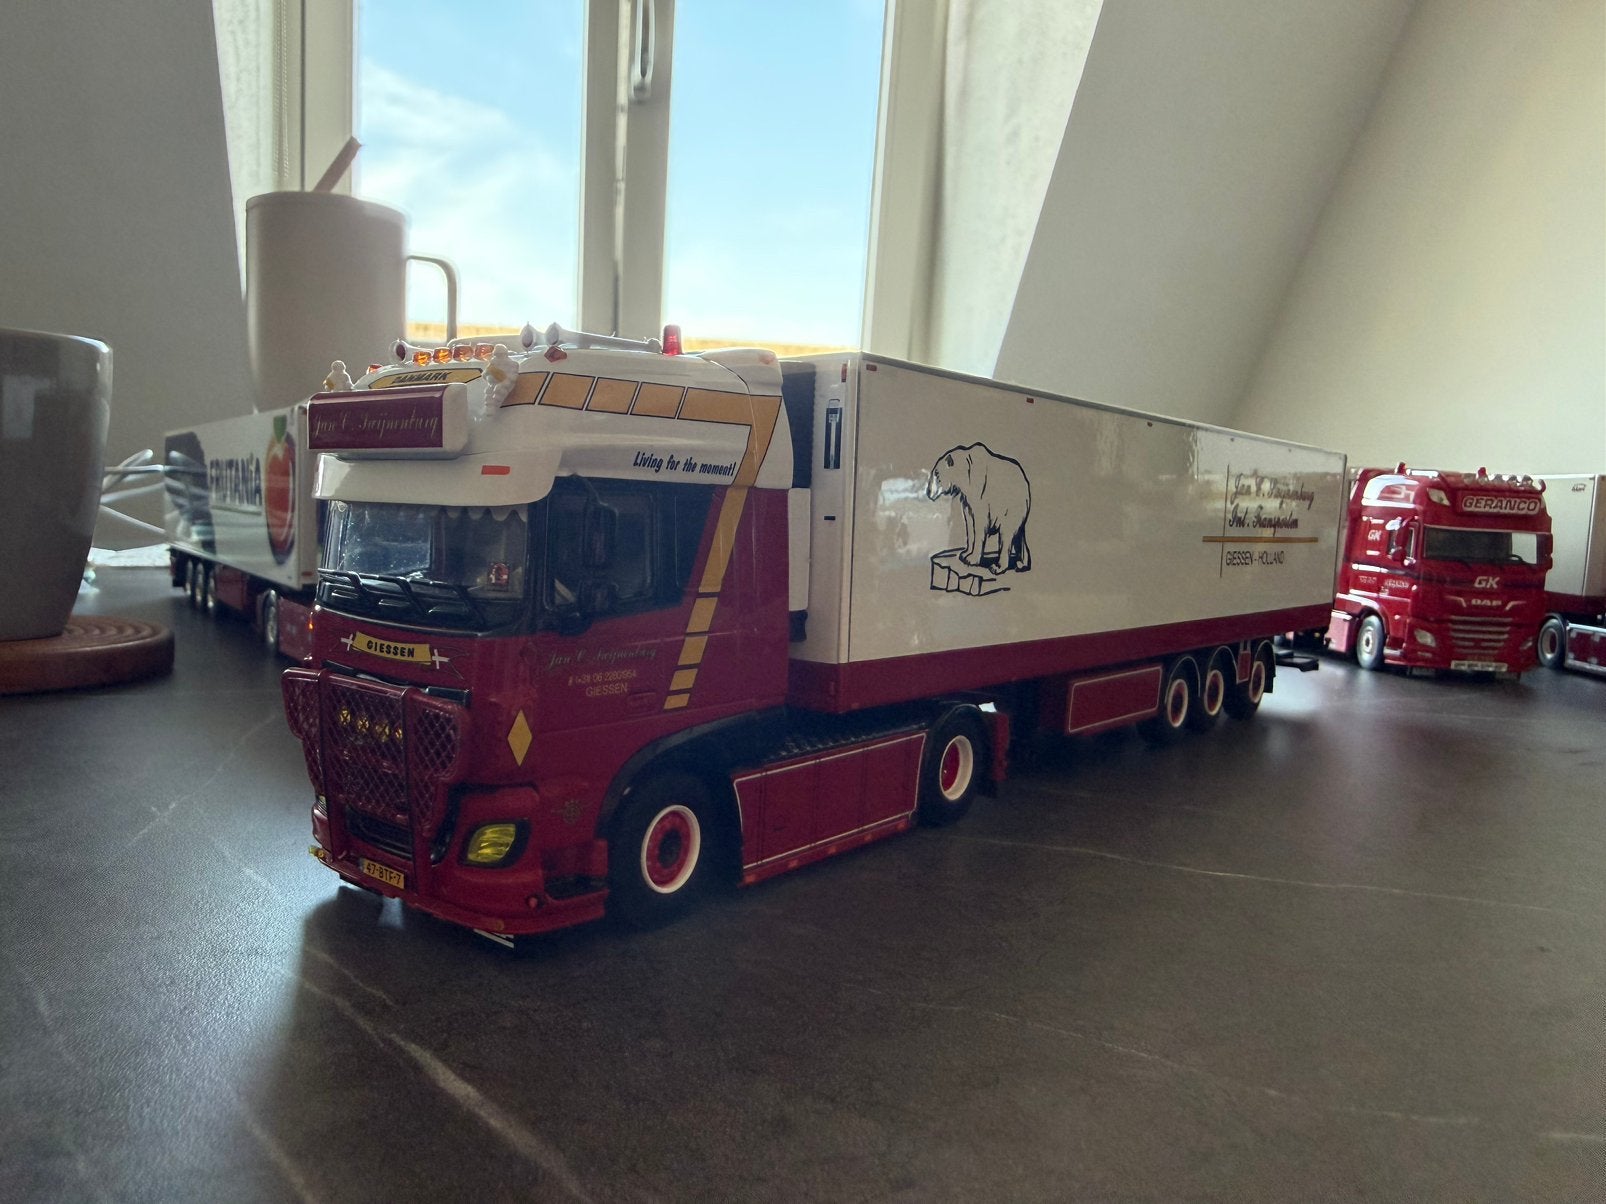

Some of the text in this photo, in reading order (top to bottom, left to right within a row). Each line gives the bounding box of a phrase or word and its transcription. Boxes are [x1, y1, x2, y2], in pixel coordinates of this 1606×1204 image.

[391, 371, 452, 384] DANMARK
[311, 414, 337, 439] Jan
[633, 450, 737, 477] Living for the moment!
[1462, 496, 1539, 512] GERANCO
[1473, 576, 1500, 589] GK
[366, 640, 415, 658] GIESSEN
[585, 682, 628, 697] GIESSEN
[366, 862, 401, 885] 47-BTF-7
